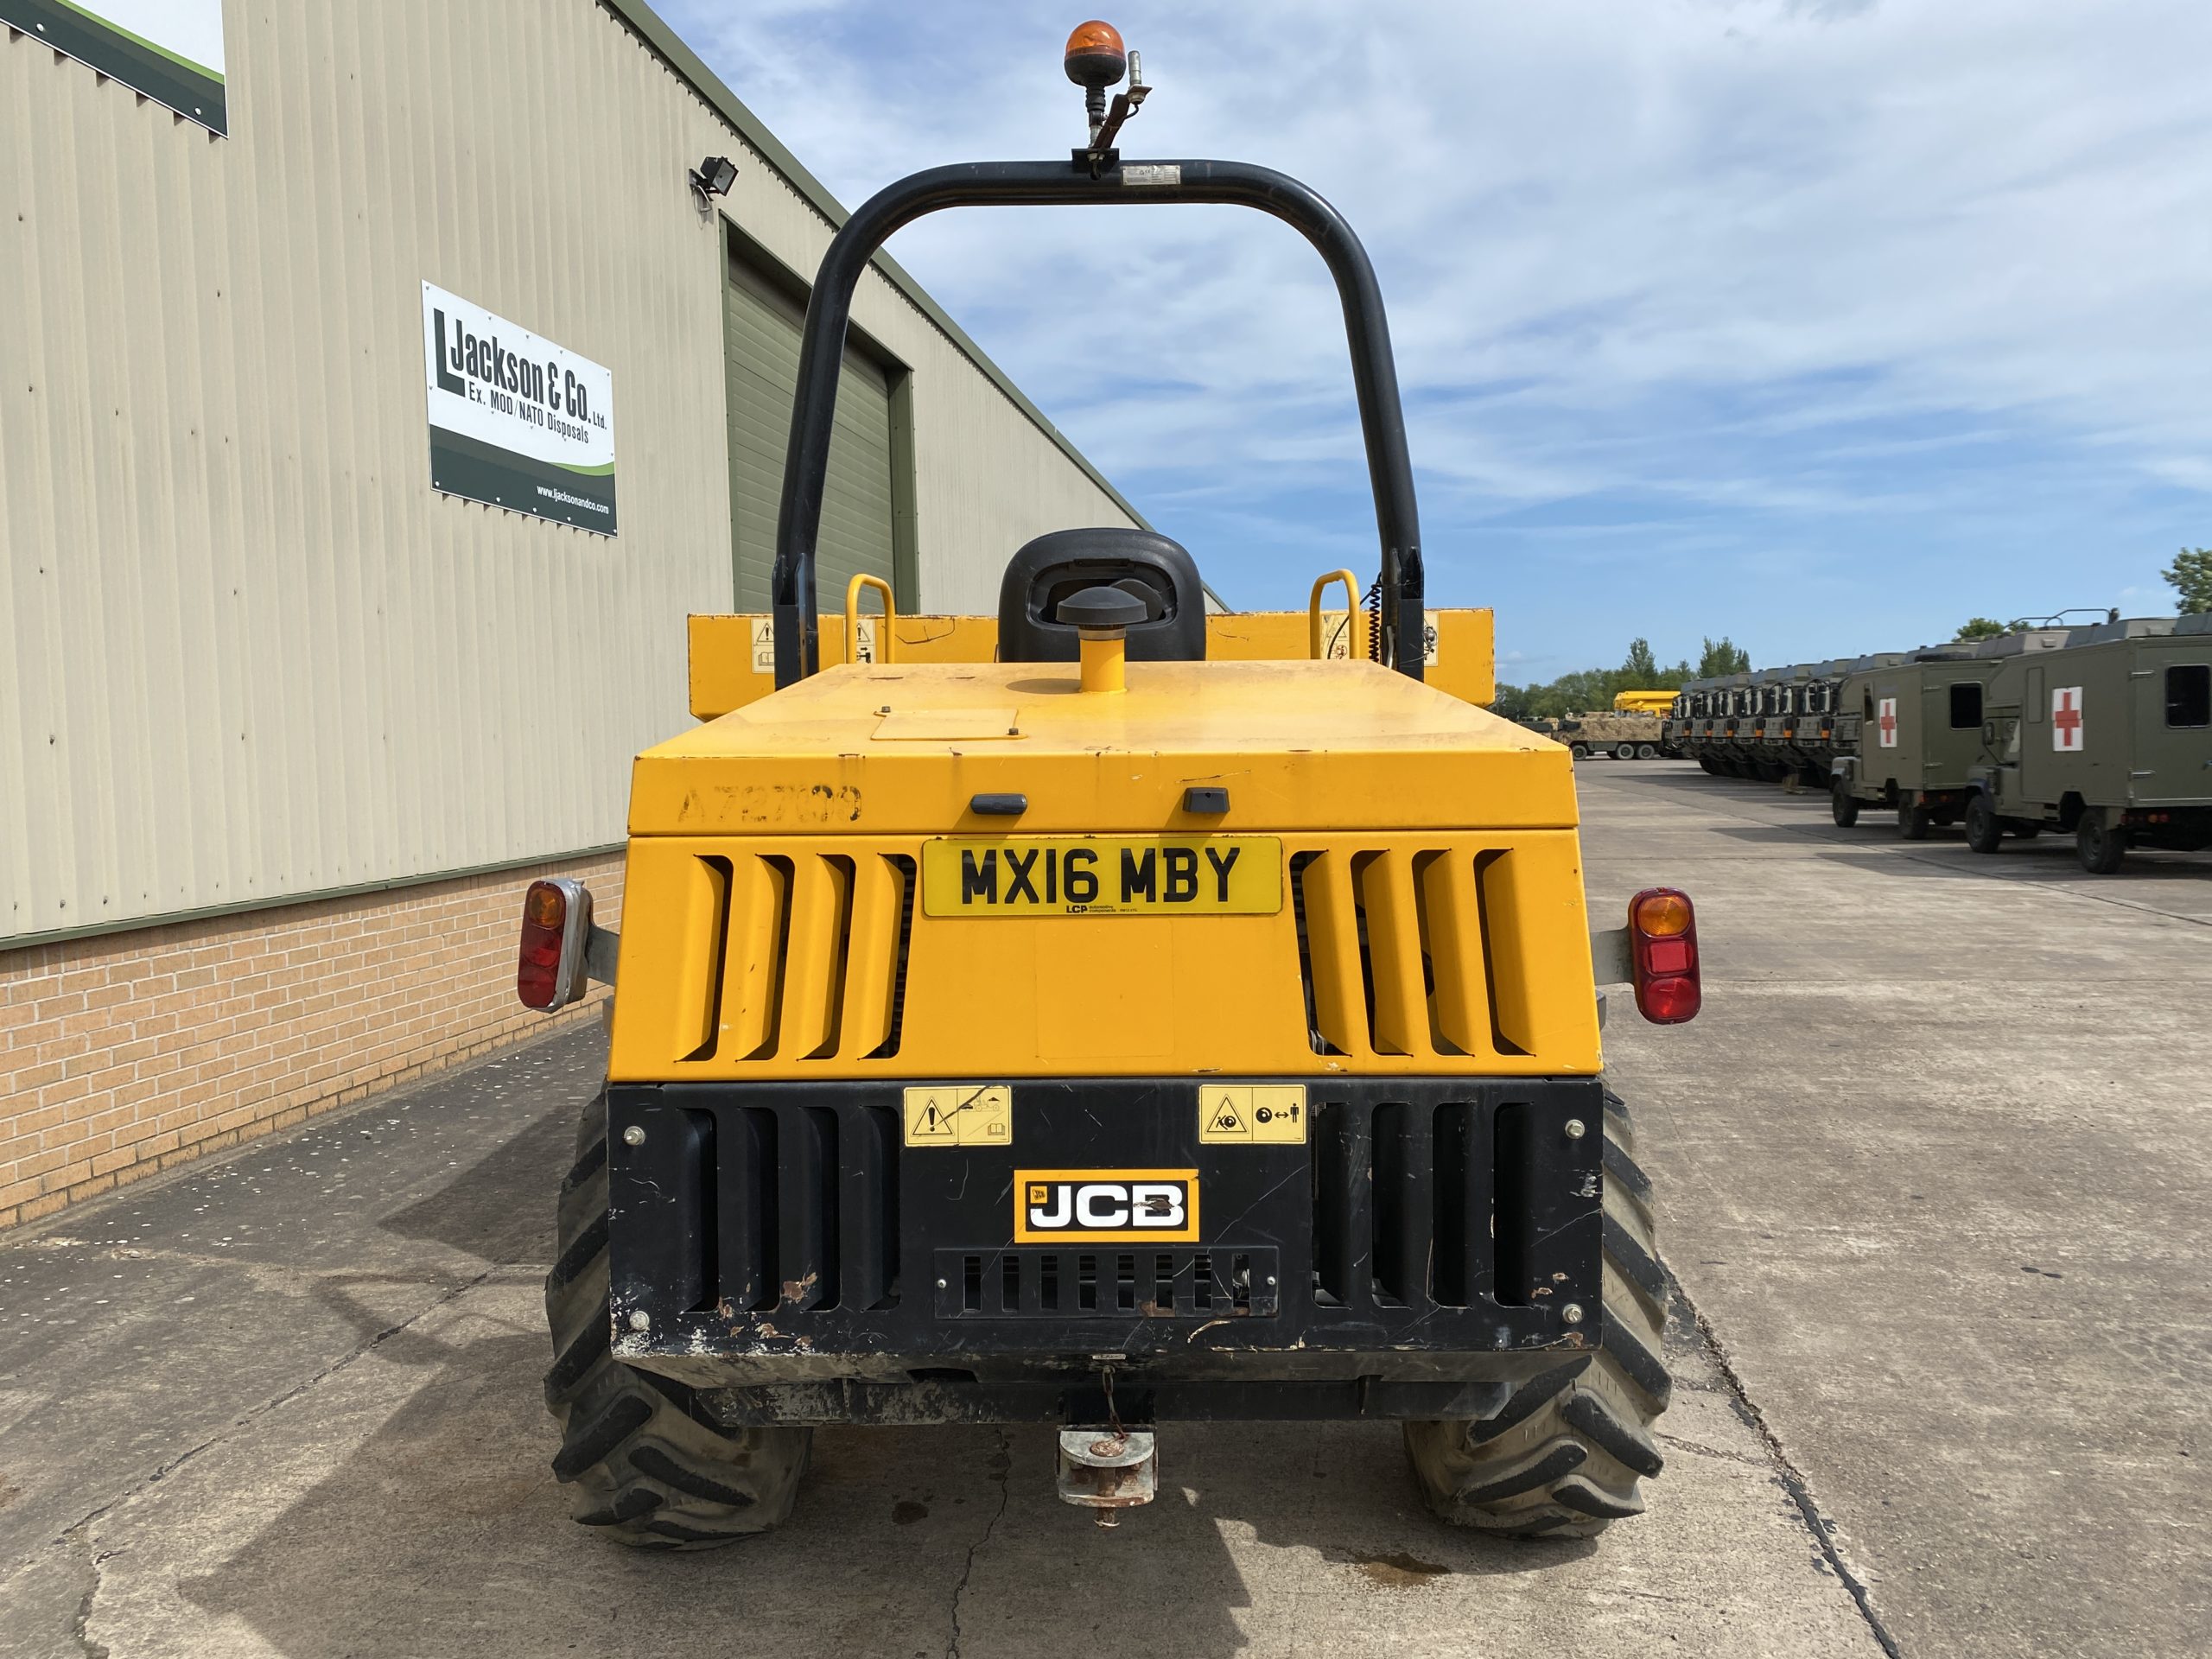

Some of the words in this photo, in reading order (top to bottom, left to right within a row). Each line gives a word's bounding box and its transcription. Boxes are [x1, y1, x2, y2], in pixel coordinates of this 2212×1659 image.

[468, 380, 486, 405] Ex.
[547, 411, 589, 444] Disposals
[547, 361, 562, 410] &
[564, 369, 592, 423] Co.
[593, 411, 607, 430] Ltd.
[537, 485, 609, 514] www.ljacksonandco.com
[961, 848, 1099, 905] MX16
[1120, 847, 1241, 903] MBY
[1066, 905, 1088, 913] LCP
[1030, 1184, 1185, 1228] JCB
